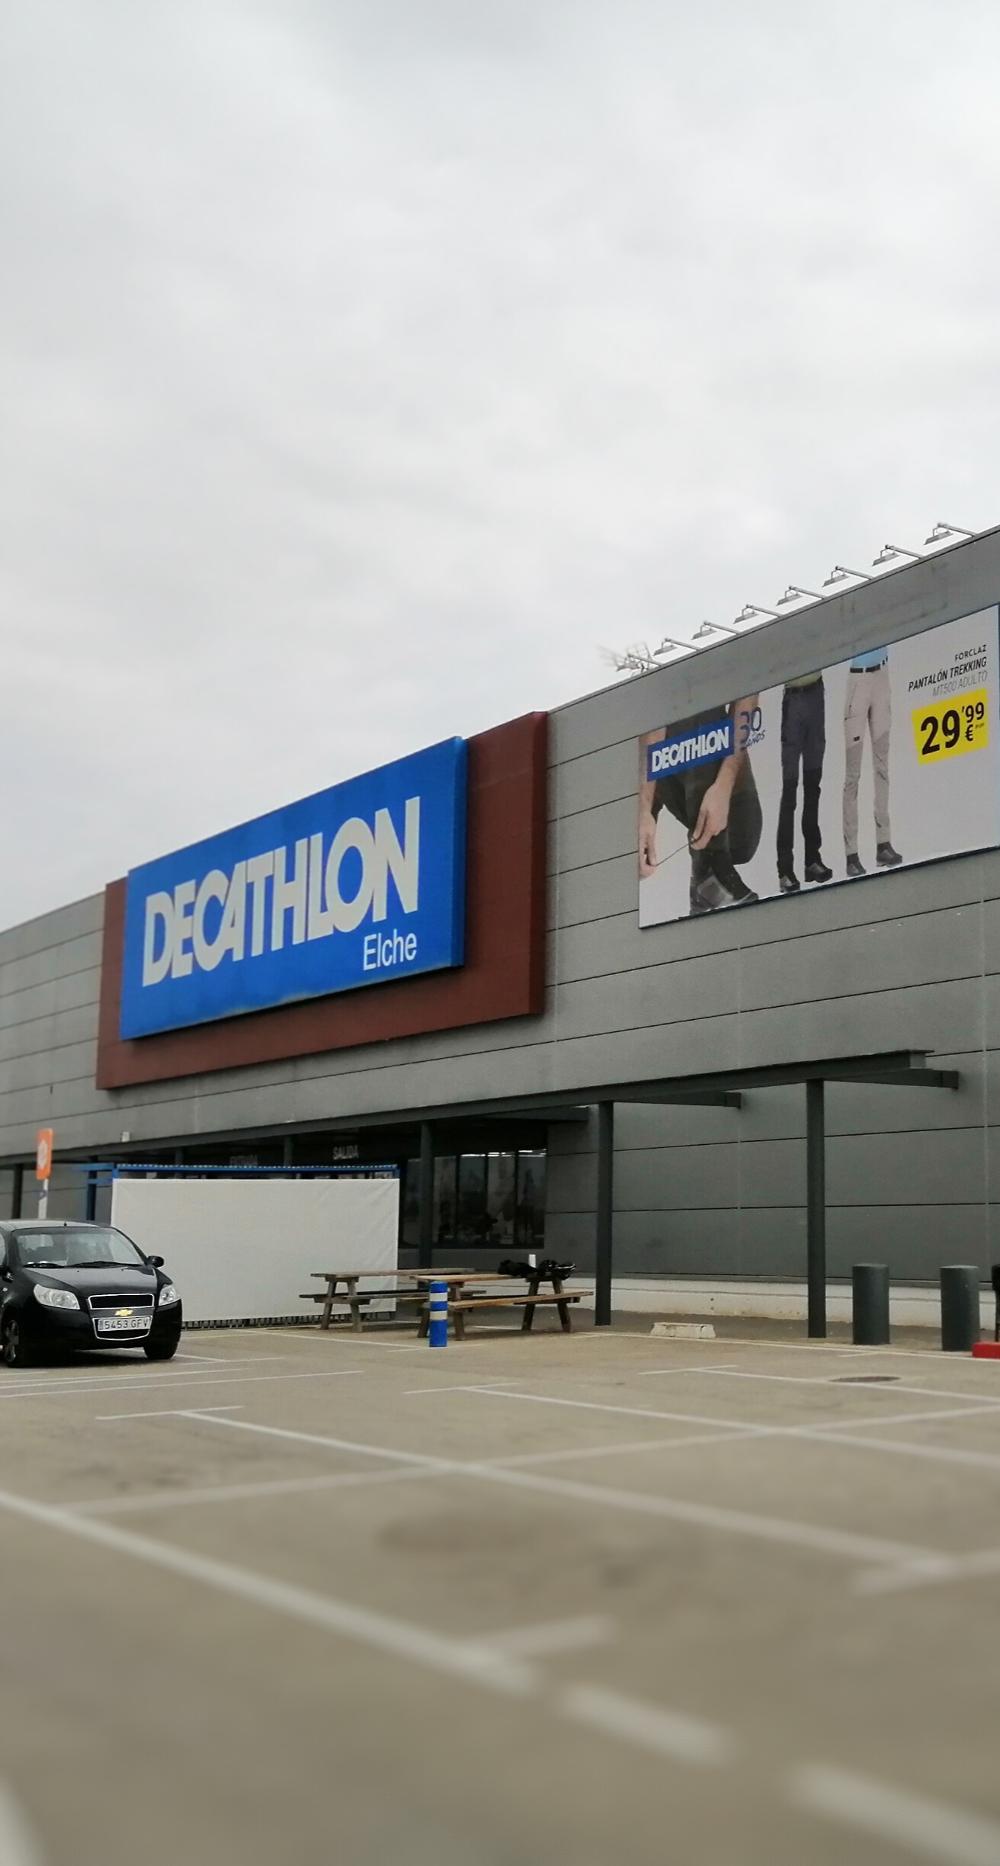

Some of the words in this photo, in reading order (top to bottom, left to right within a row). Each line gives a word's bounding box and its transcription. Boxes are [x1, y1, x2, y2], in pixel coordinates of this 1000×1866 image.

[954, 644, 987, 661] FORCLAZ
[908, 668, 948, 692] PANTALÓN
[950, 656, 987, 679] TREKKING
[651, 726, 729, 772] DECATHLON
[142, 796, 420, 987] DECATHLON
[363, 928, 417, 971] Elche
[333, 1145, 359, 1160] SALIDA
[104, 1320, 128, 1330] 5453
